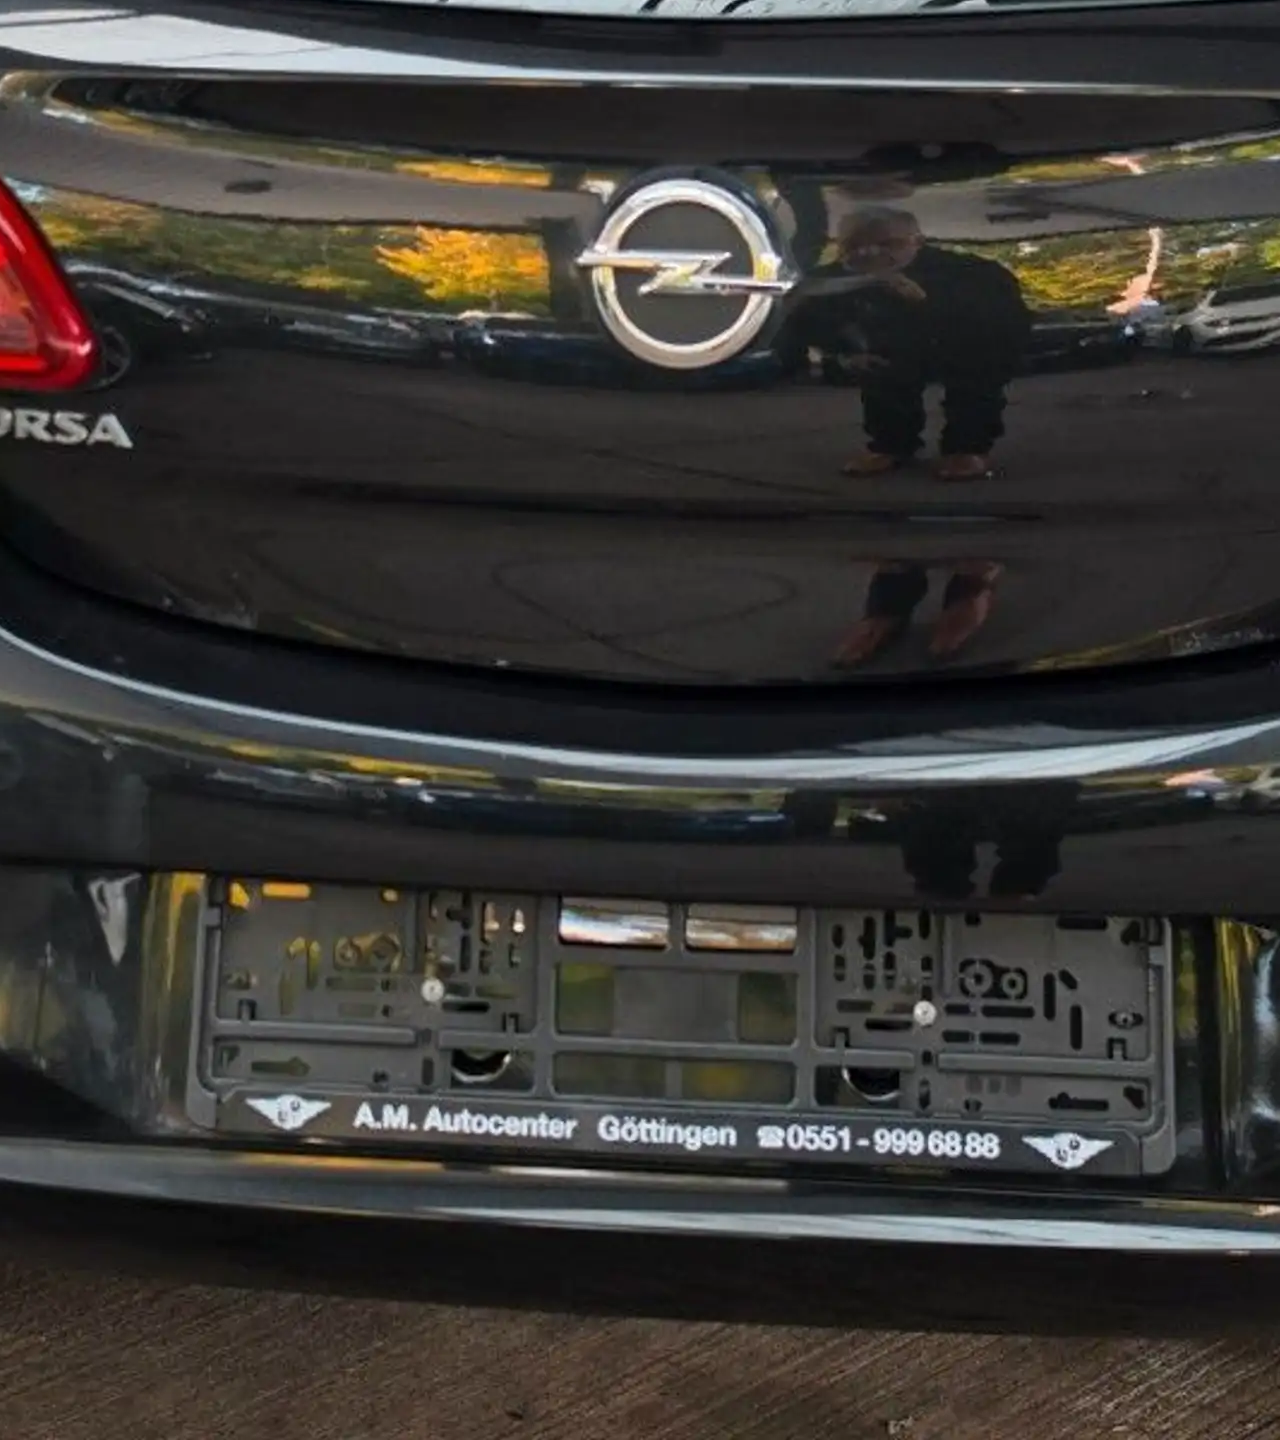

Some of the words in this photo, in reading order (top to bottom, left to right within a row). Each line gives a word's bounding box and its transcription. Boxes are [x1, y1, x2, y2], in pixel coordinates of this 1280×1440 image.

[353, 1102, 416, 1132] A.M.
[424, 1106, 577, 1139] Autocenter
[597, 1115, 738, 1151] Göttingen
